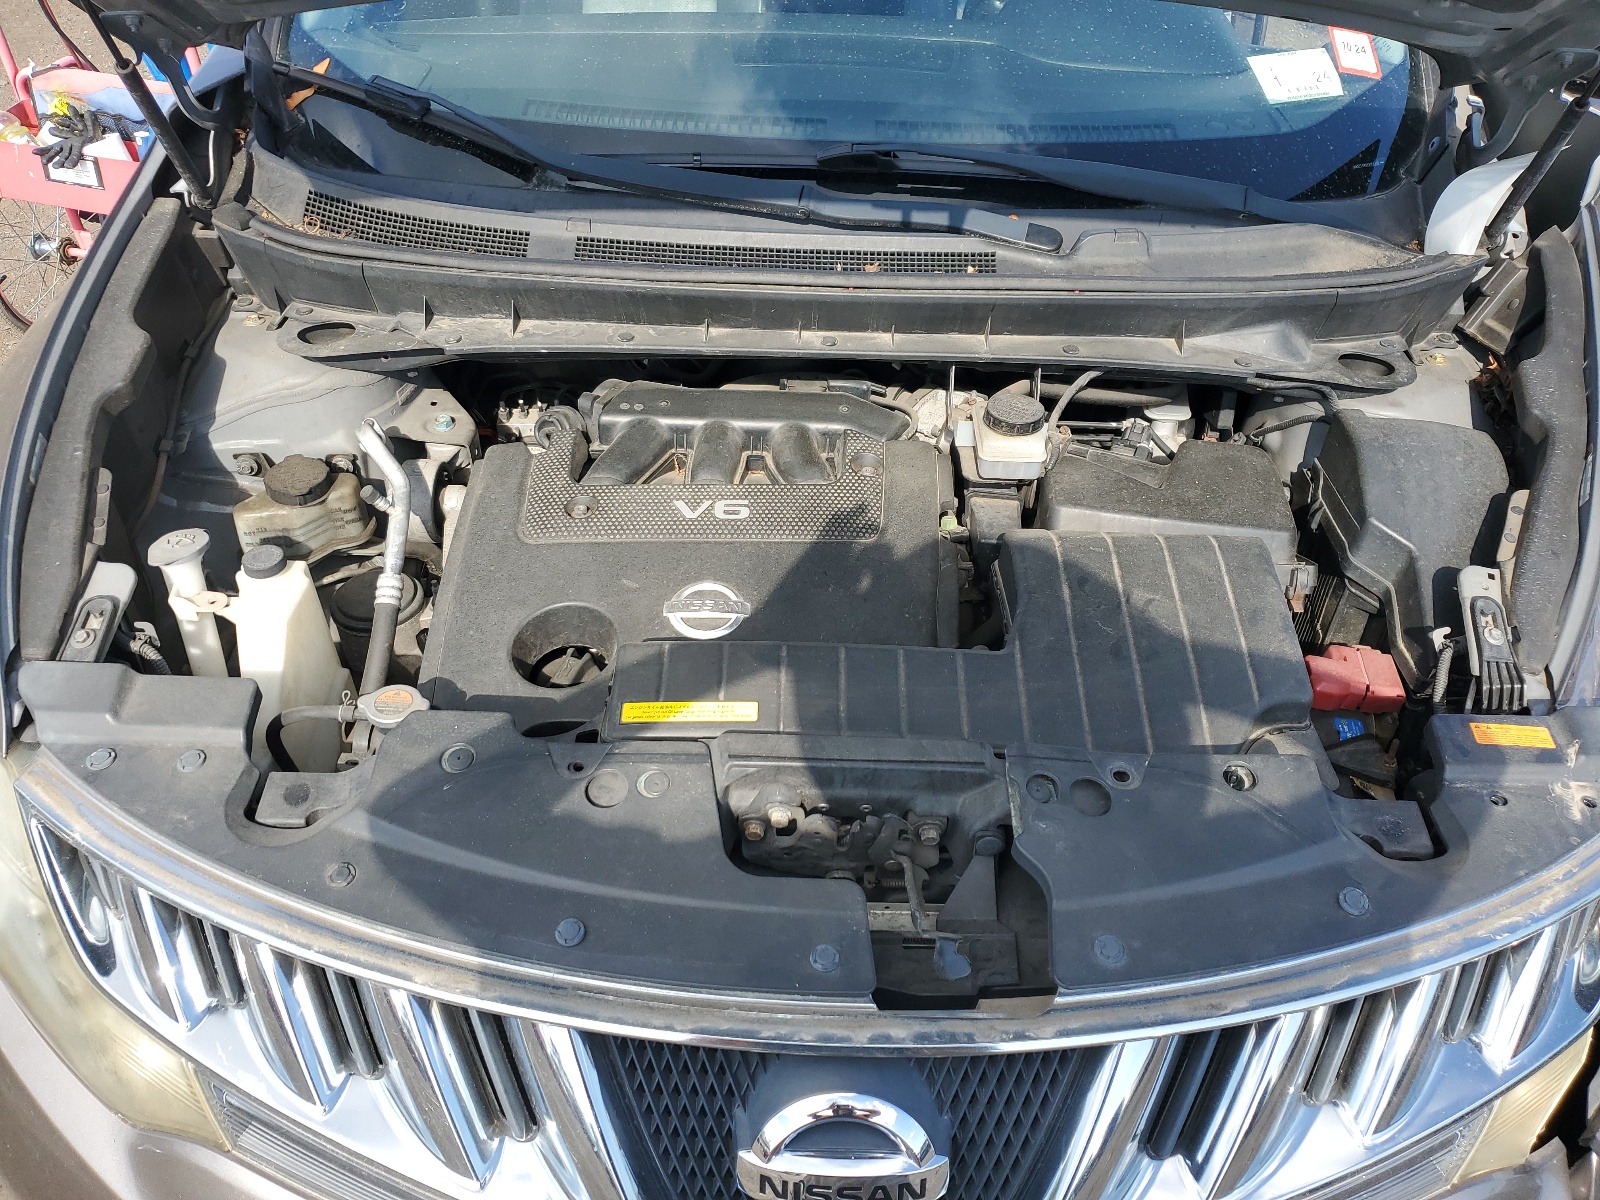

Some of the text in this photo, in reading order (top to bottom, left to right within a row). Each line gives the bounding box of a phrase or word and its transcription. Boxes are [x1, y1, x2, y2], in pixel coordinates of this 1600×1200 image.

[1354, 44, 1367, 55] 24
[673, 500, 750, 519] V6
[672, 600, 742, 611] NISSAN
[759, 1173, 928, 1200] NISSAN
